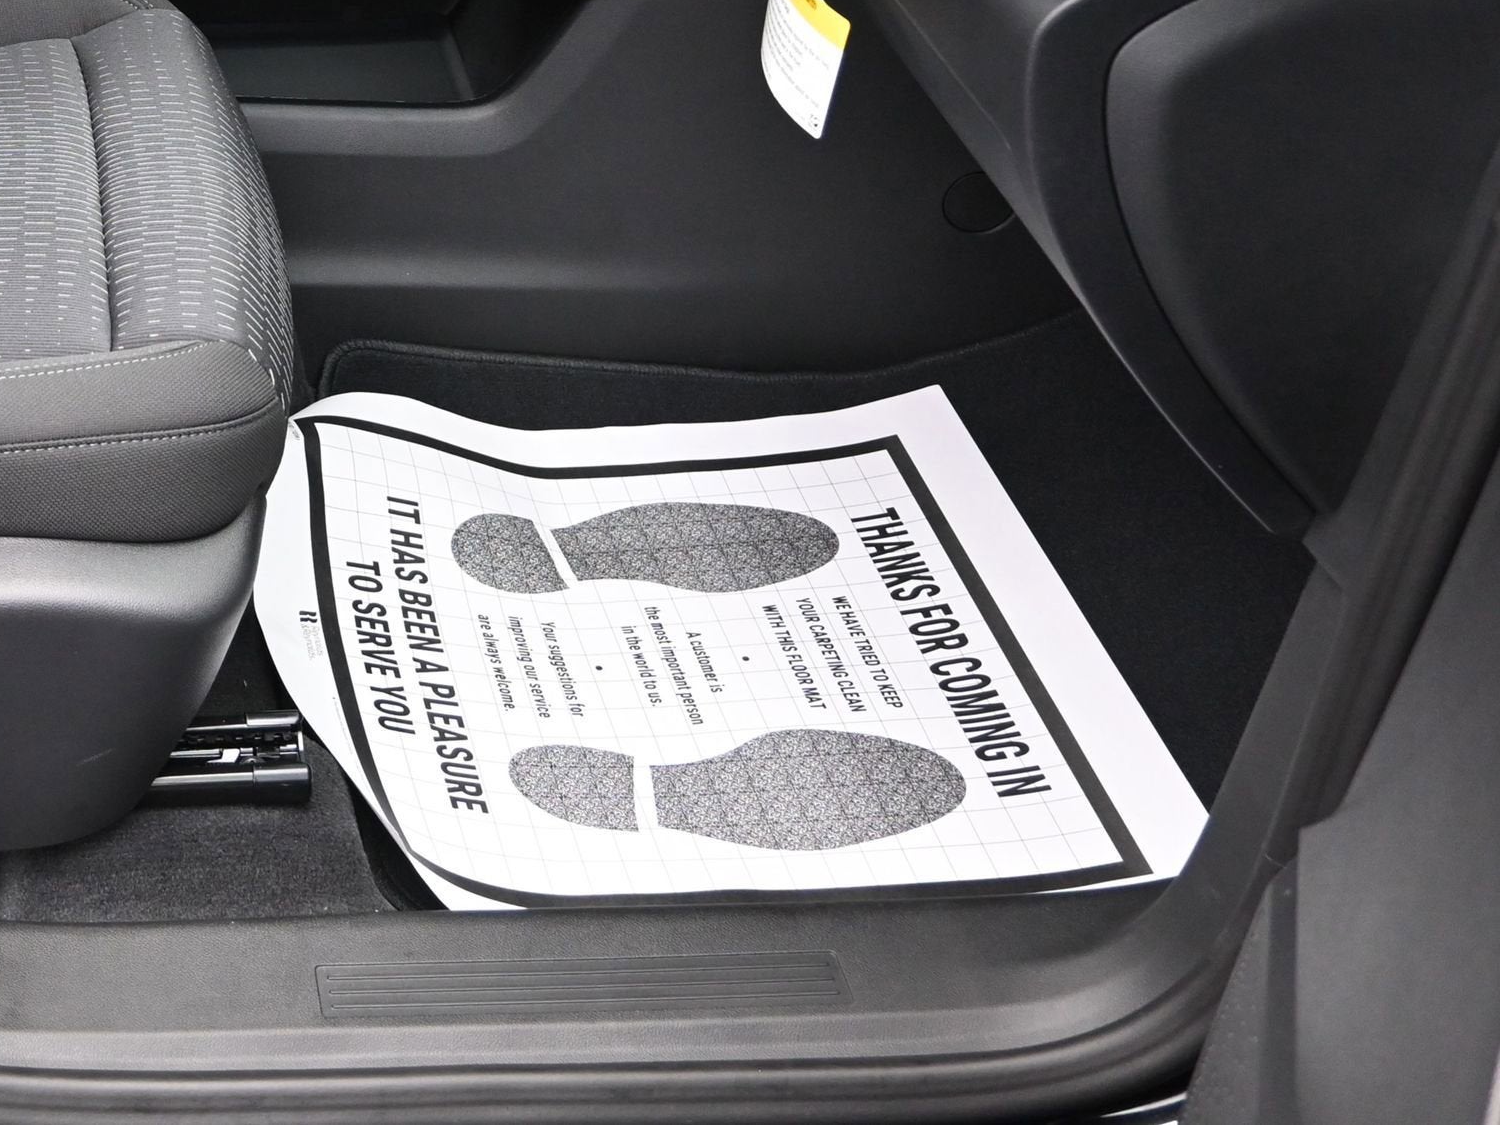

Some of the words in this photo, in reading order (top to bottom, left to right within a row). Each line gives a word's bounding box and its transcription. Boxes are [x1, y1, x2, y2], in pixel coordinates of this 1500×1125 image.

[387, 497, 420, 524] IT
[390, 529, 428, 584] HAS
[851, 507, 940, 601] THANKS
[347, 561, 383, 592] TO
[644, 606, 661, 621] the
[761, 604, 787, 629] WITH
[831, 595, 853, 611] WE
[399, 589, 444, 652] BEEN
[477, 614, 492, 631] are
[541, 621, 558, 643] Your
[621, 625, 637, 635] in
[650, 622, 672, 645] most
[838, 610, 867, 638] HAVE
[900, 604, 968, 654] FOR
[352, 600, 401, 678] SERVE
[482, 632, 502, 665] always
[507, 616, 533, 663] improving
[625, 635, 642, 651] the
[685, 631, 702, 639] A
[774, 629, 799, 653] THIS
[413, 658, 449, 673] A
[632, 652, 656, 678] world
[689, 640, 719, 682] customer
[795, 597, 821, 623] YOUR
[808, 624, 850, 679] CARPETING
[836, 679, 867, 713] CLEAN
[853, 638, 882, 667] TRIED
[523, 664, 539, 681] our
[547, 644, 578, 701] suggestions
[661, 645, 692, 691] important
[785, 653, 815, 686] FLOOR
[869, 667, 890, 682] TO
[492, 666, 516, 712] welcome.
[642, 679, 657, 690] to
[709, 684, 725, 693] is
[801, 686, 828, 710] MAT
[877, 683, 904, 709] KEEP
[370, 687, 415, 734] YOU
[528, 682, 551, 719] service
[569, 703, 586, 717] for
[647, 692, 663, 707] us.
[675, 692, 704, 725] person
[930, 658, 1029, 761] COMING
[419, 682, 488, 813] PLEASURE
[987, 766, 1051, 797] IN
